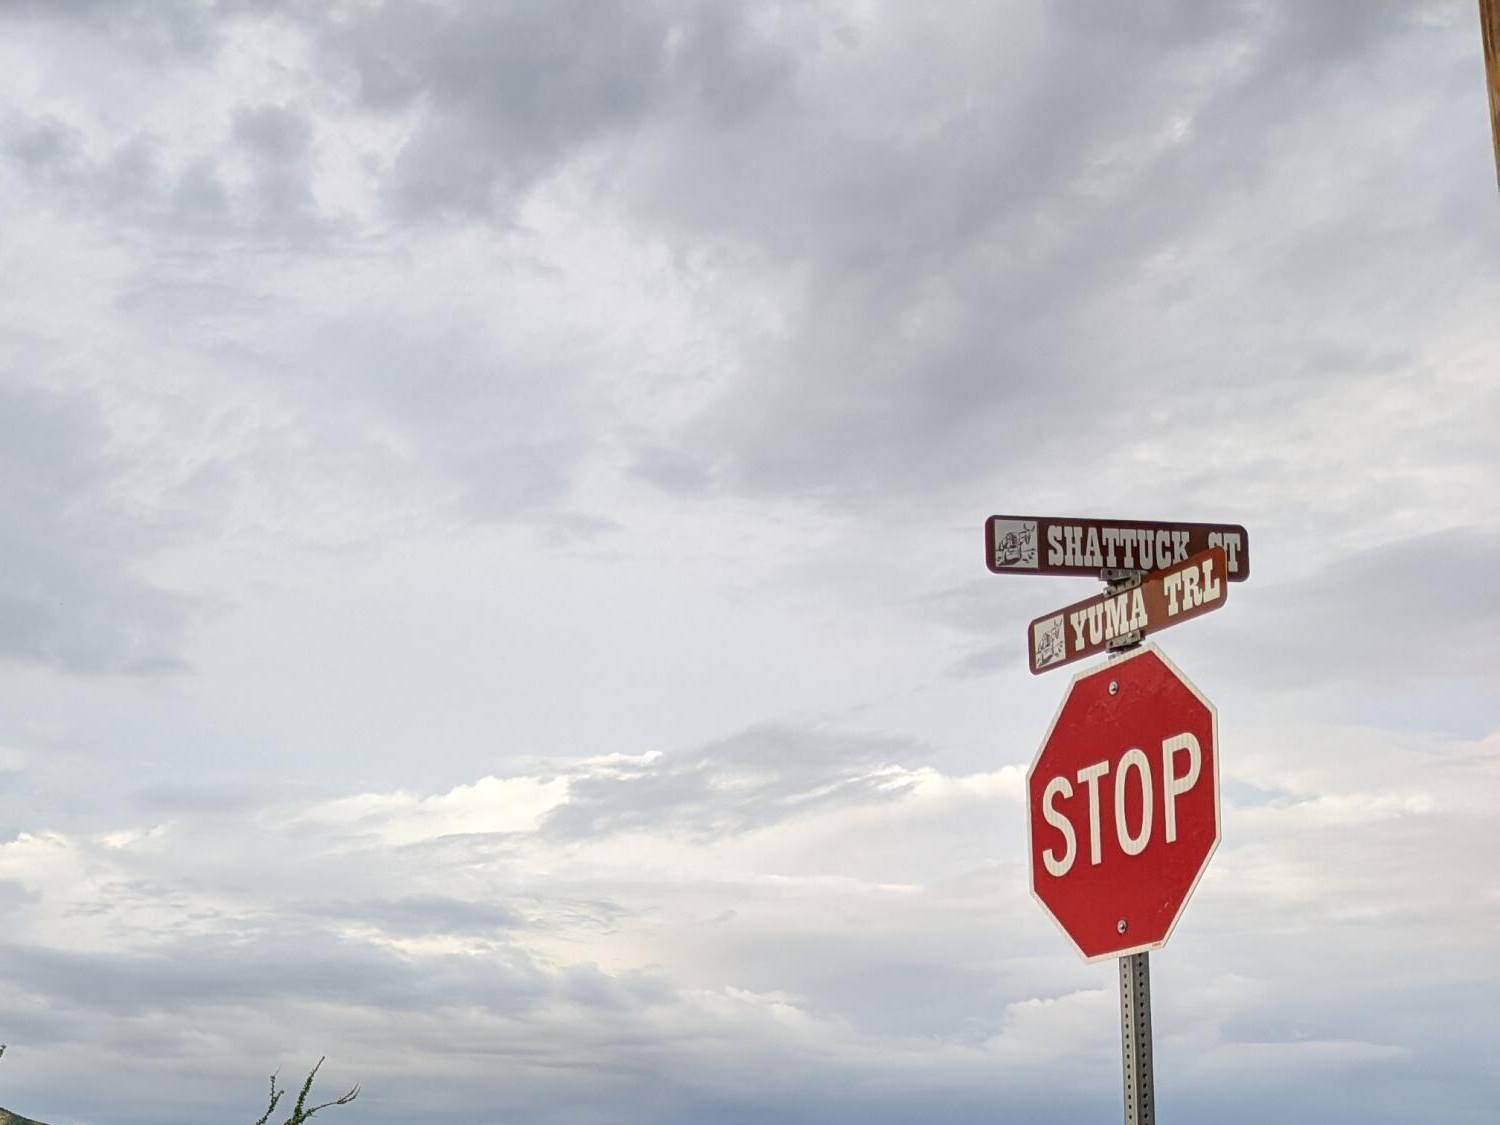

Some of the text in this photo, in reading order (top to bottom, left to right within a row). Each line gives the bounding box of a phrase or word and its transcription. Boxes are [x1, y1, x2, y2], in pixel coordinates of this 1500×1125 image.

[1047, 525, 1190, 570] SHATTUCK
[1070, 558, 1221, 651] YUMA TRL
[1042, 732, 1202, 877] STOP
